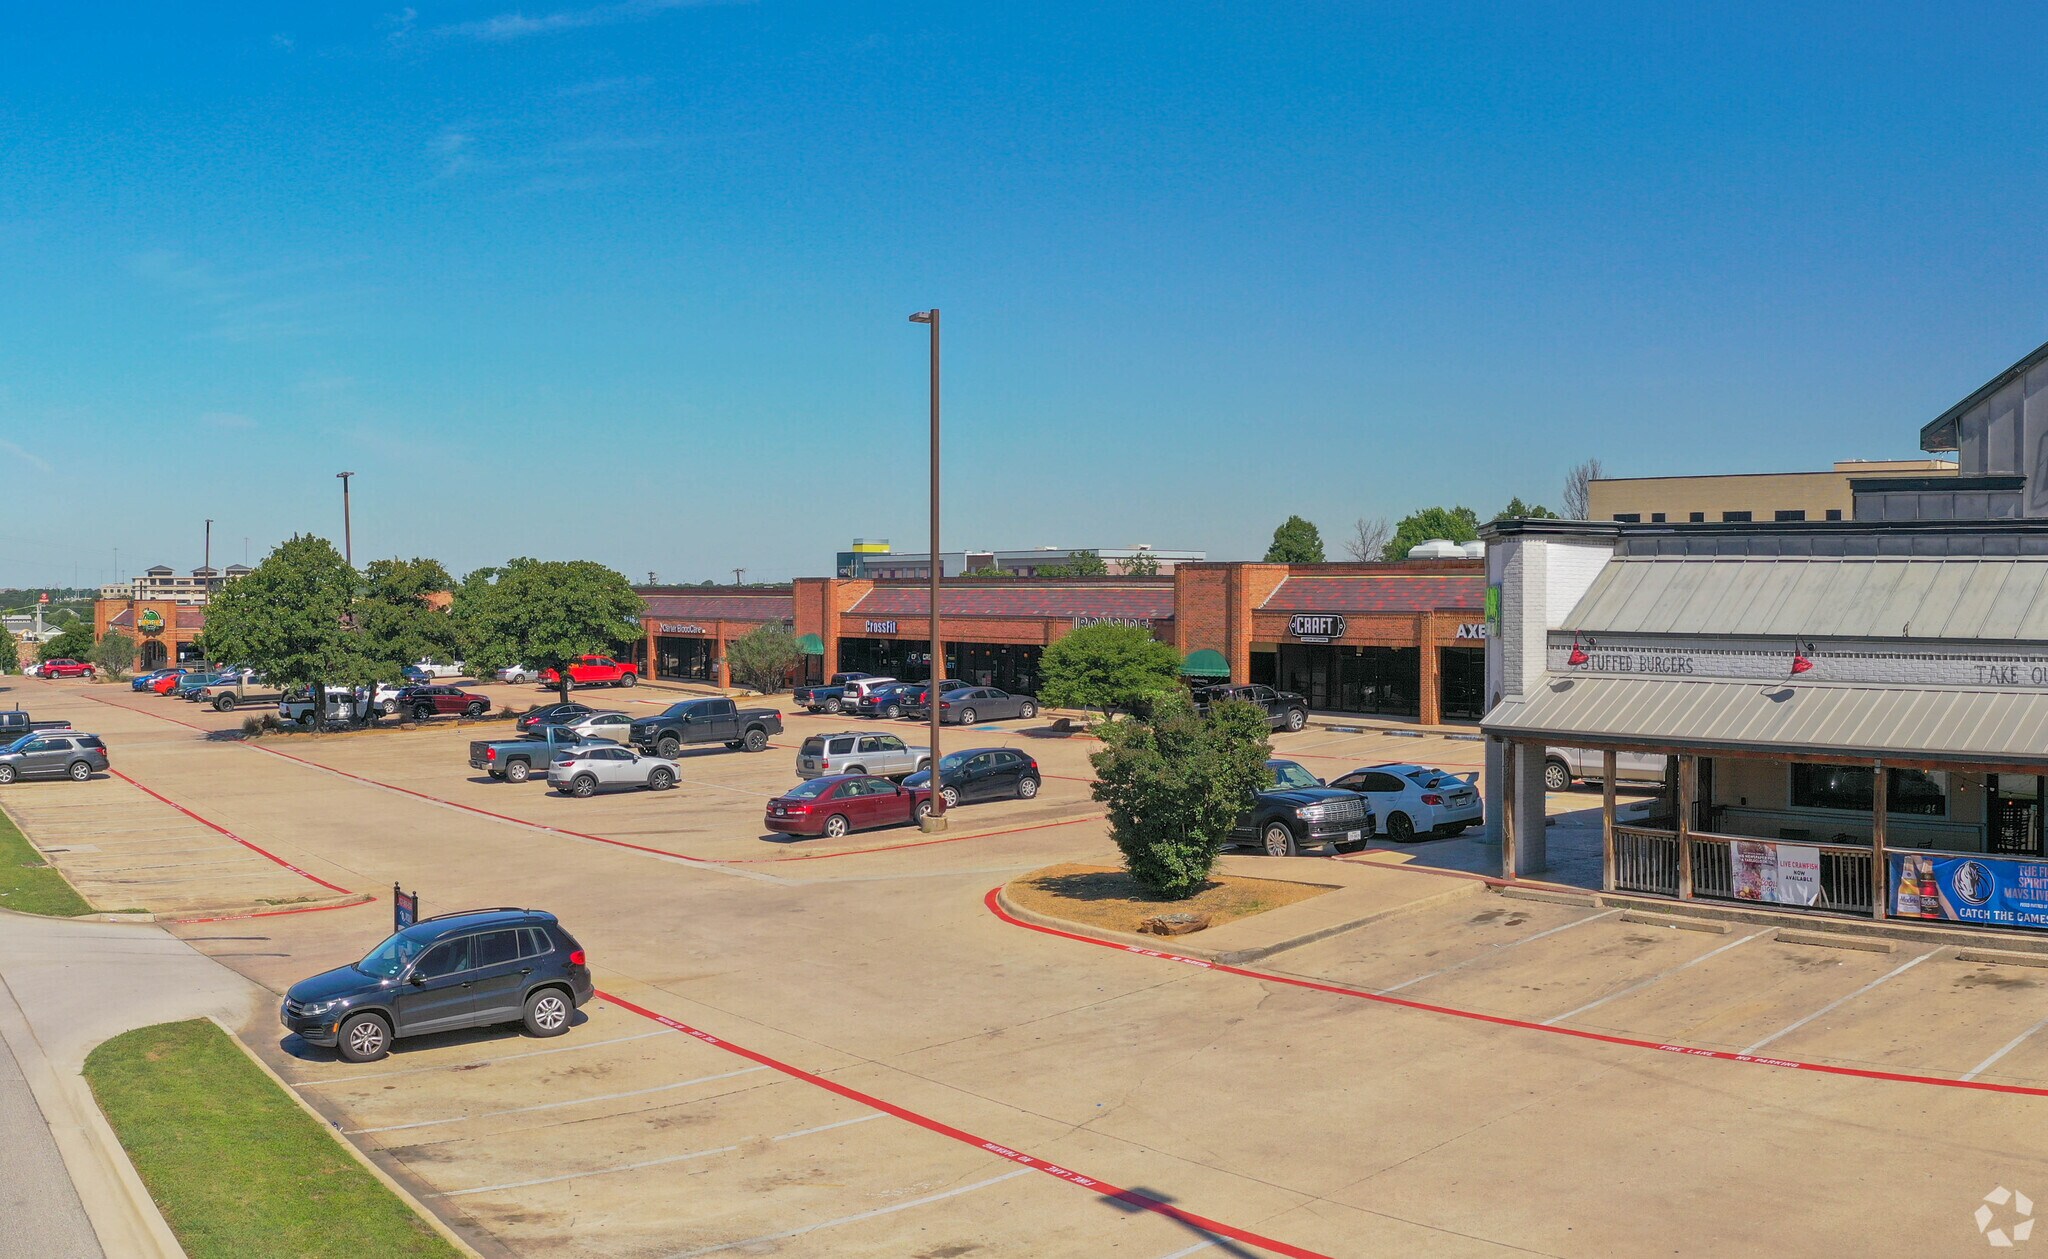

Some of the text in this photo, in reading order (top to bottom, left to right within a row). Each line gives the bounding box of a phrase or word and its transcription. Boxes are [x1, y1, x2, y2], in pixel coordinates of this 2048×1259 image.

[865, 620, 896, 634] CrossFit
[1296, 617, 1333, 634] CRAFT
[1639, 655, 1694, 674] BURGERS
[1974, 665, 2019, 685] TAKE
[1780, 860, 1819, 870] LIVE CRAWFISH
[2018, 865, 2037, 877] THE
[1785, 875, 1813, 883] AVAILABLE
[2004, 887, 2029, 900] MAVS
[1959, 907, 1991, 920] CATCH
[1993, 910, 2015, 921] THE
[1659, 1044, 1684, 1053] FIRE
[1687, 1049, 1717, 1058] LANE
[1754, 1057, 1800, 1068] PARKING
